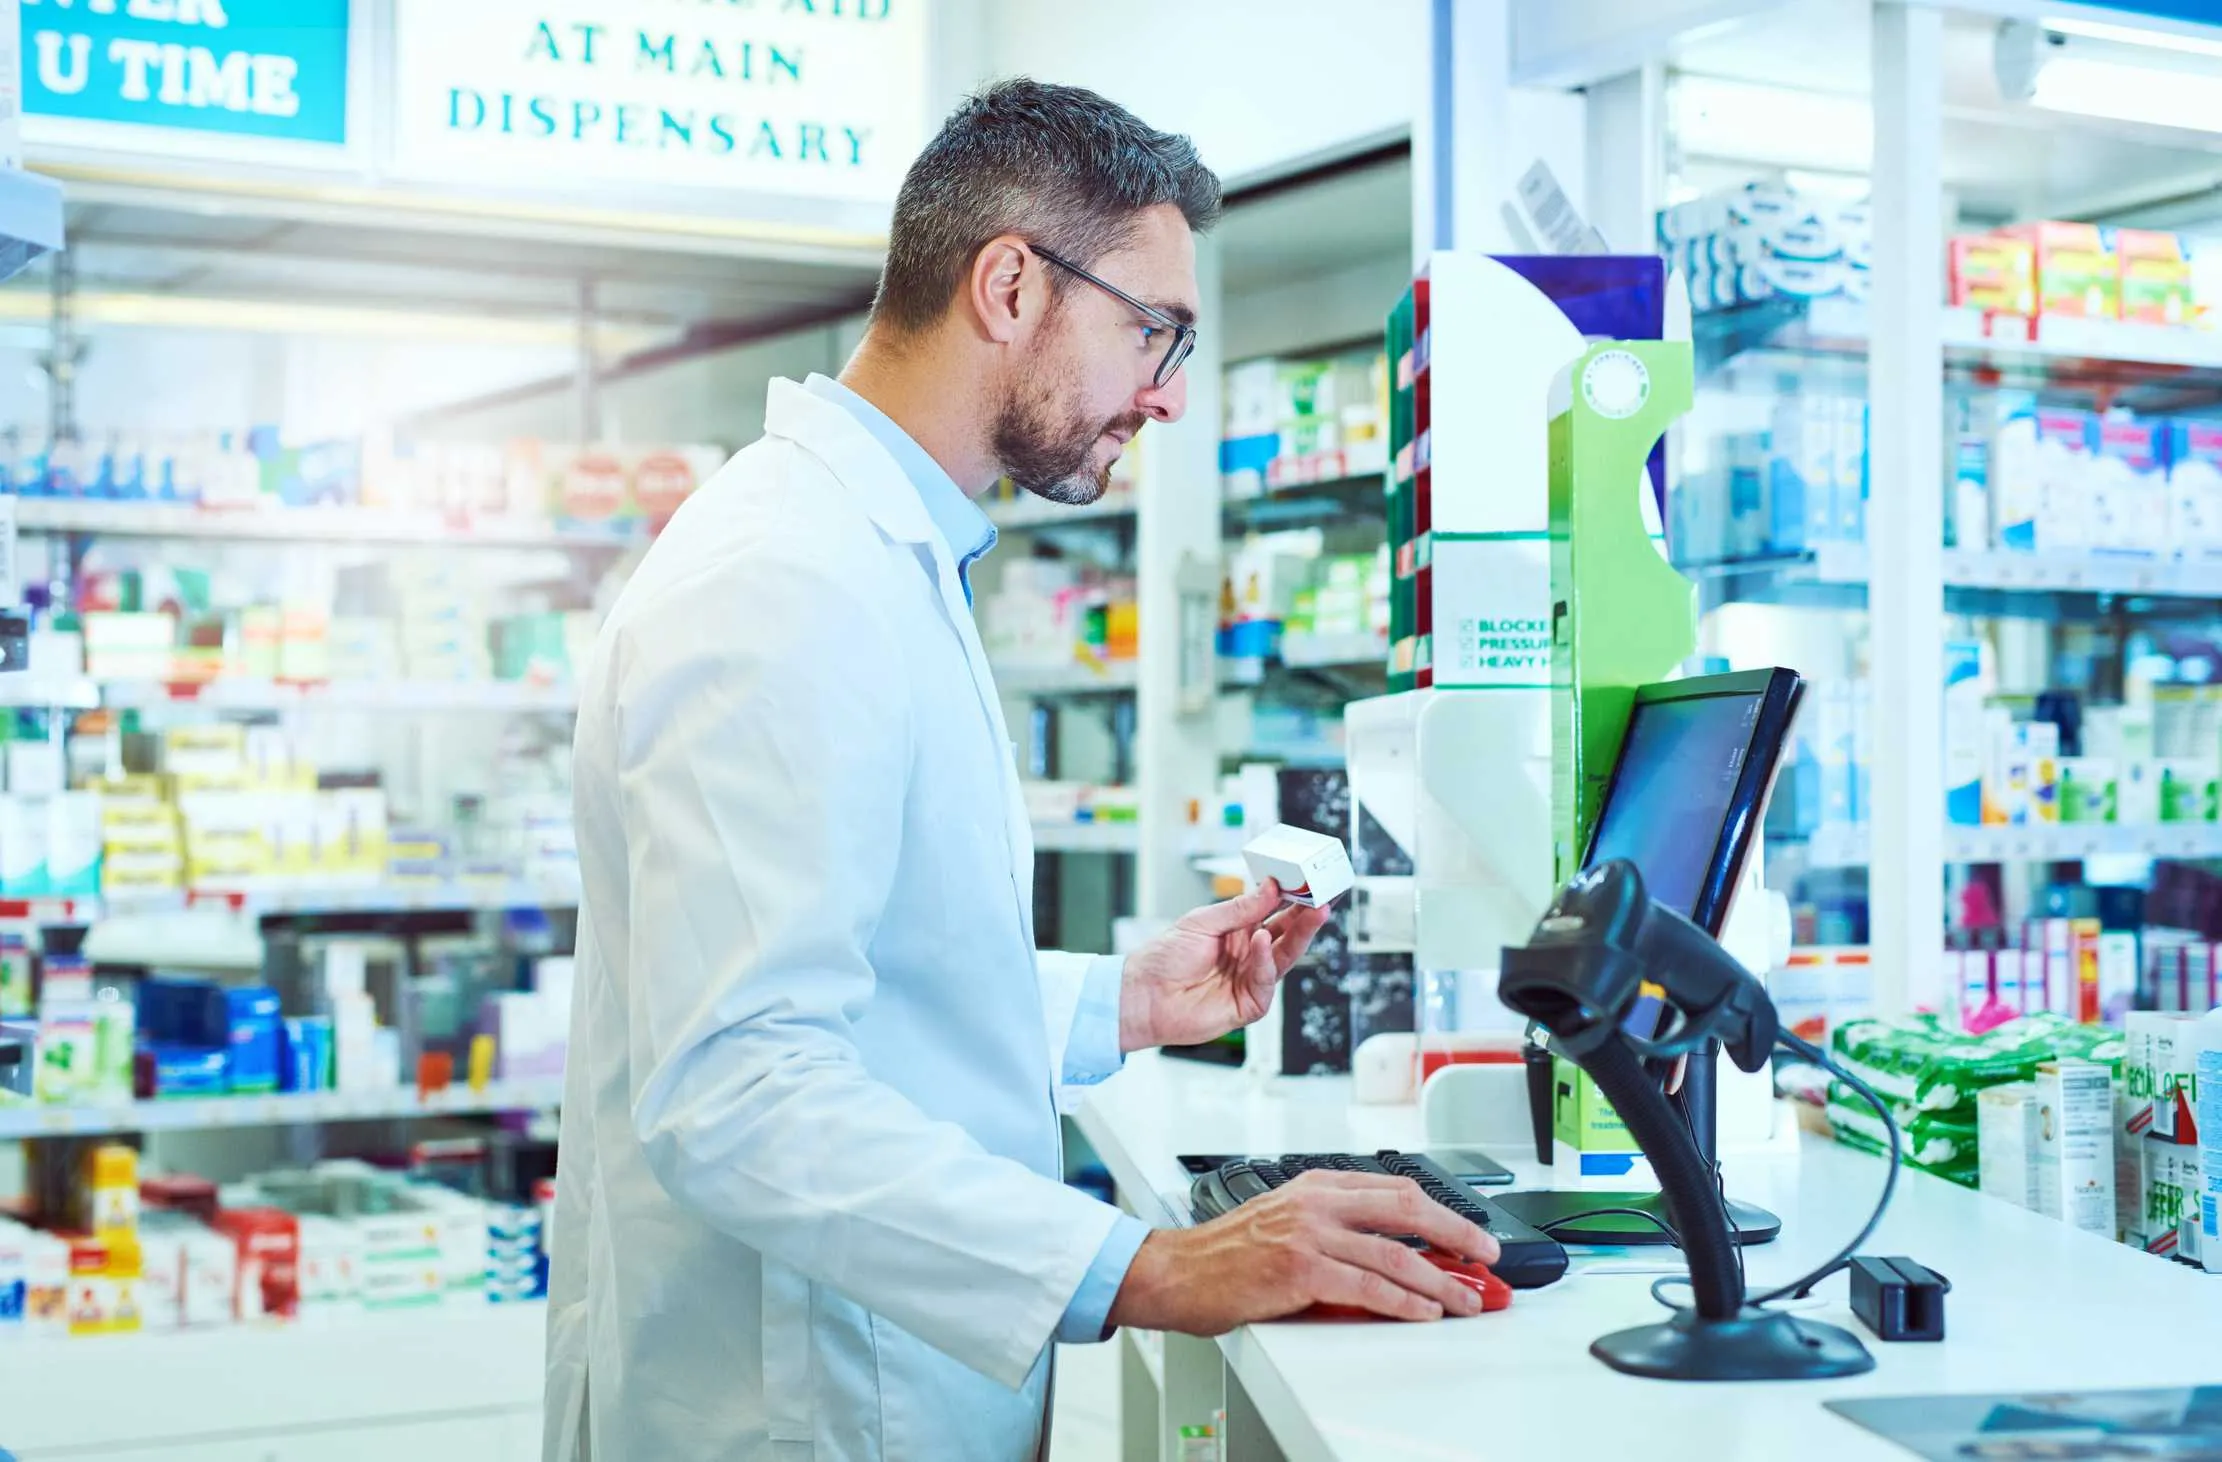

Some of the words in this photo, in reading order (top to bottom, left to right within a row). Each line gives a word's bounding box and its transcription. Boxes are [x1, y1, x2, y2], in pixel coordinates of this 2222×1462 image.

[34, 29, 92, 94] U
[107, 37, 299, 117] TIME
[525, 19, 607, 64] AT
[635, 30, 804, 82] MAIN
[447, 86, 873, 166] DISPENSARY
[1478, 656, 1535, 668] HEAVY
